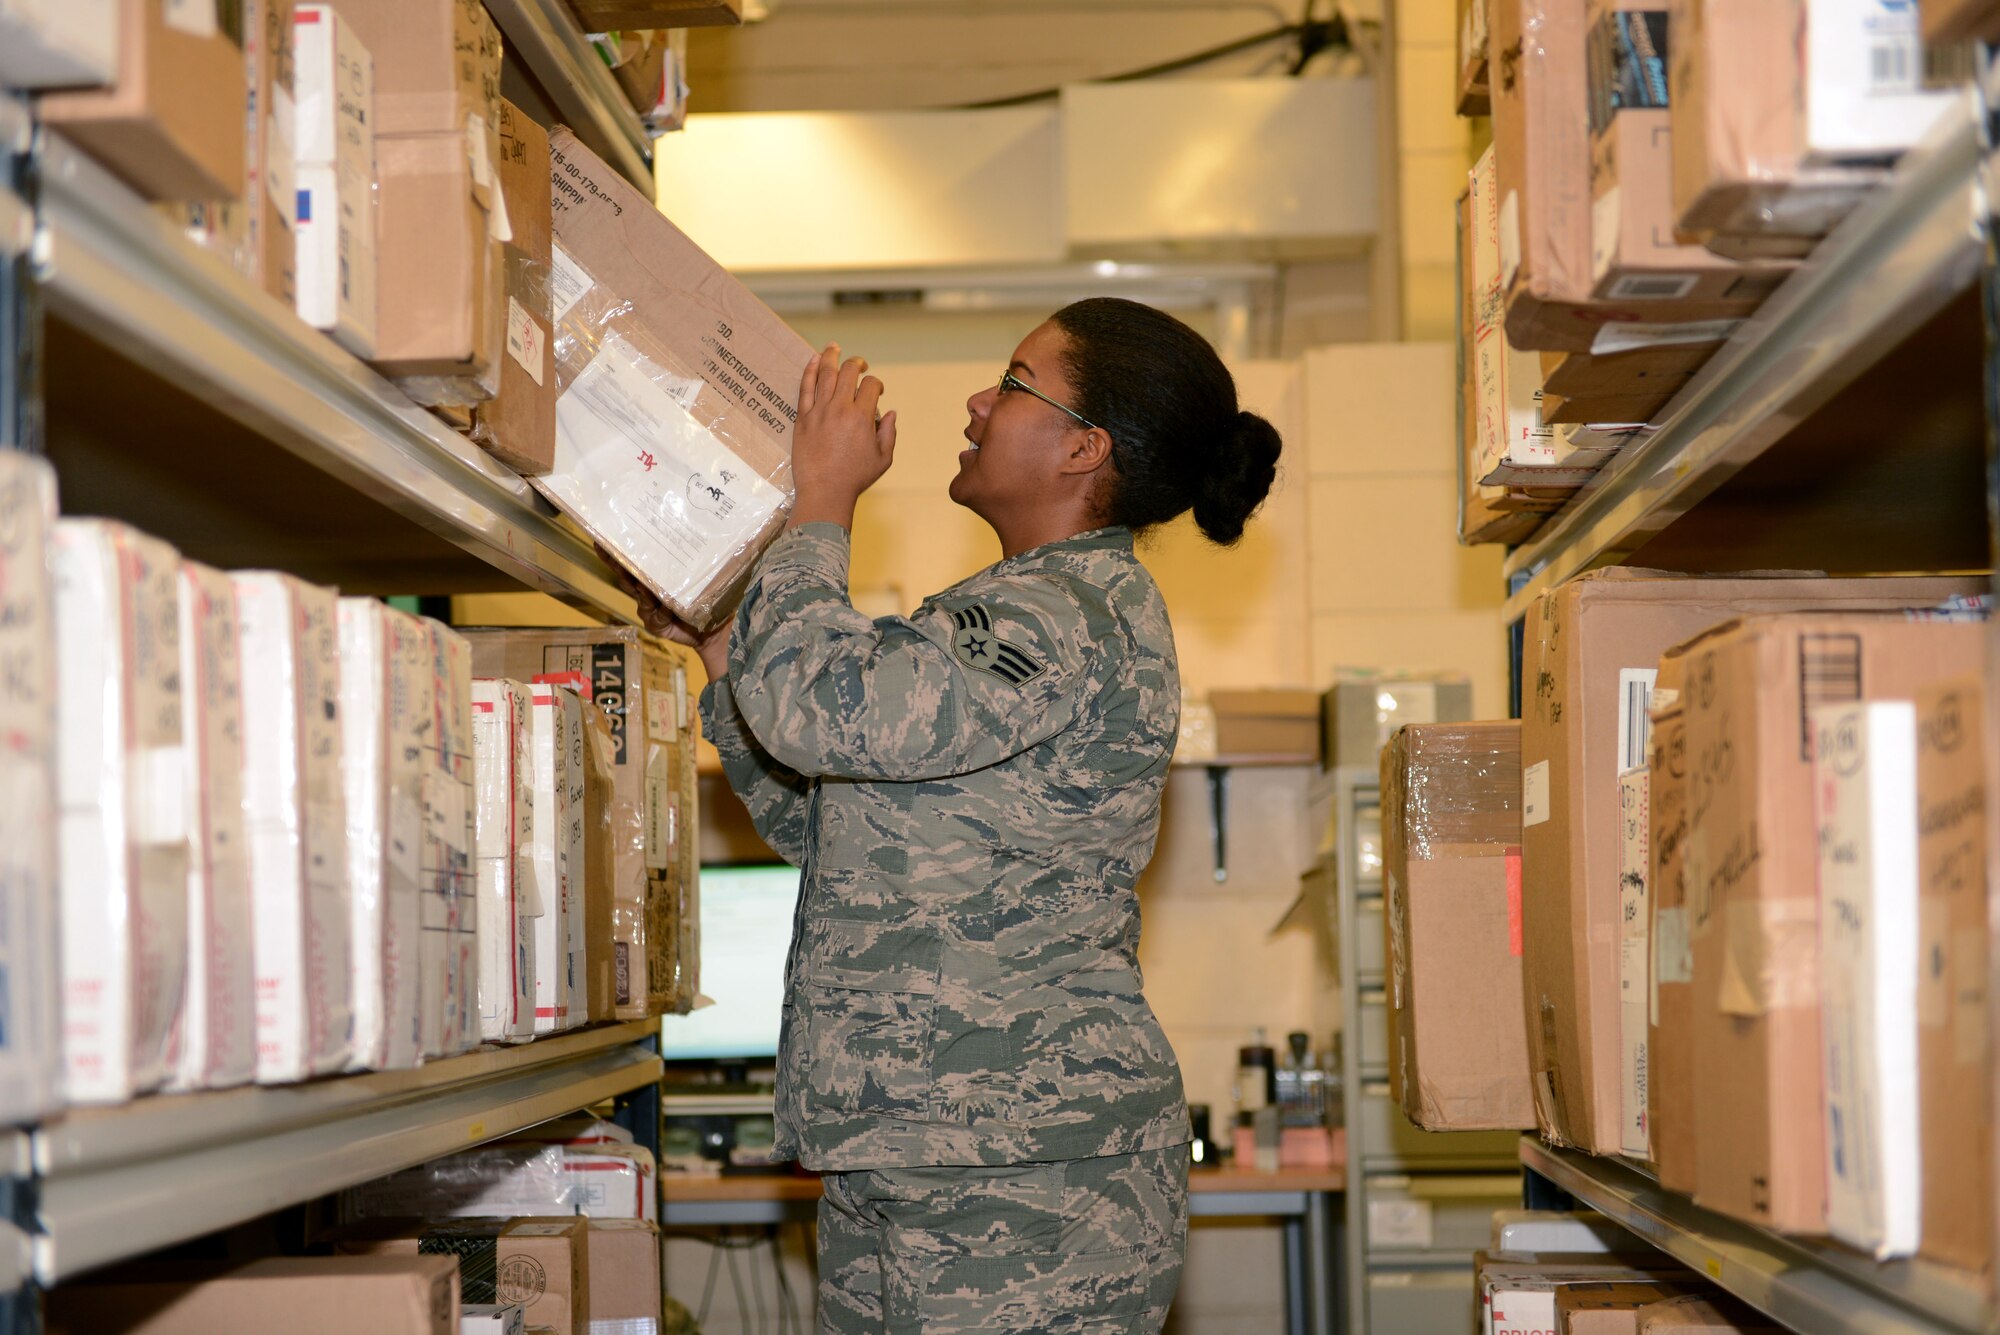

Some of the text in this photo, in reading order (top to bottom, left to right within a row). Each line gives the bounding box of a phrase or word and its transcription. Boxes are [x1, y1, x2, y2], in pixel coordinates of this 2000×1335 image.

[716, 370, 748, 403] HAVEN,
[746, 397, 761, 411] CT
[758, 408, 786, 434] 06473
[756, 382, 798, 423] CONTAINE
